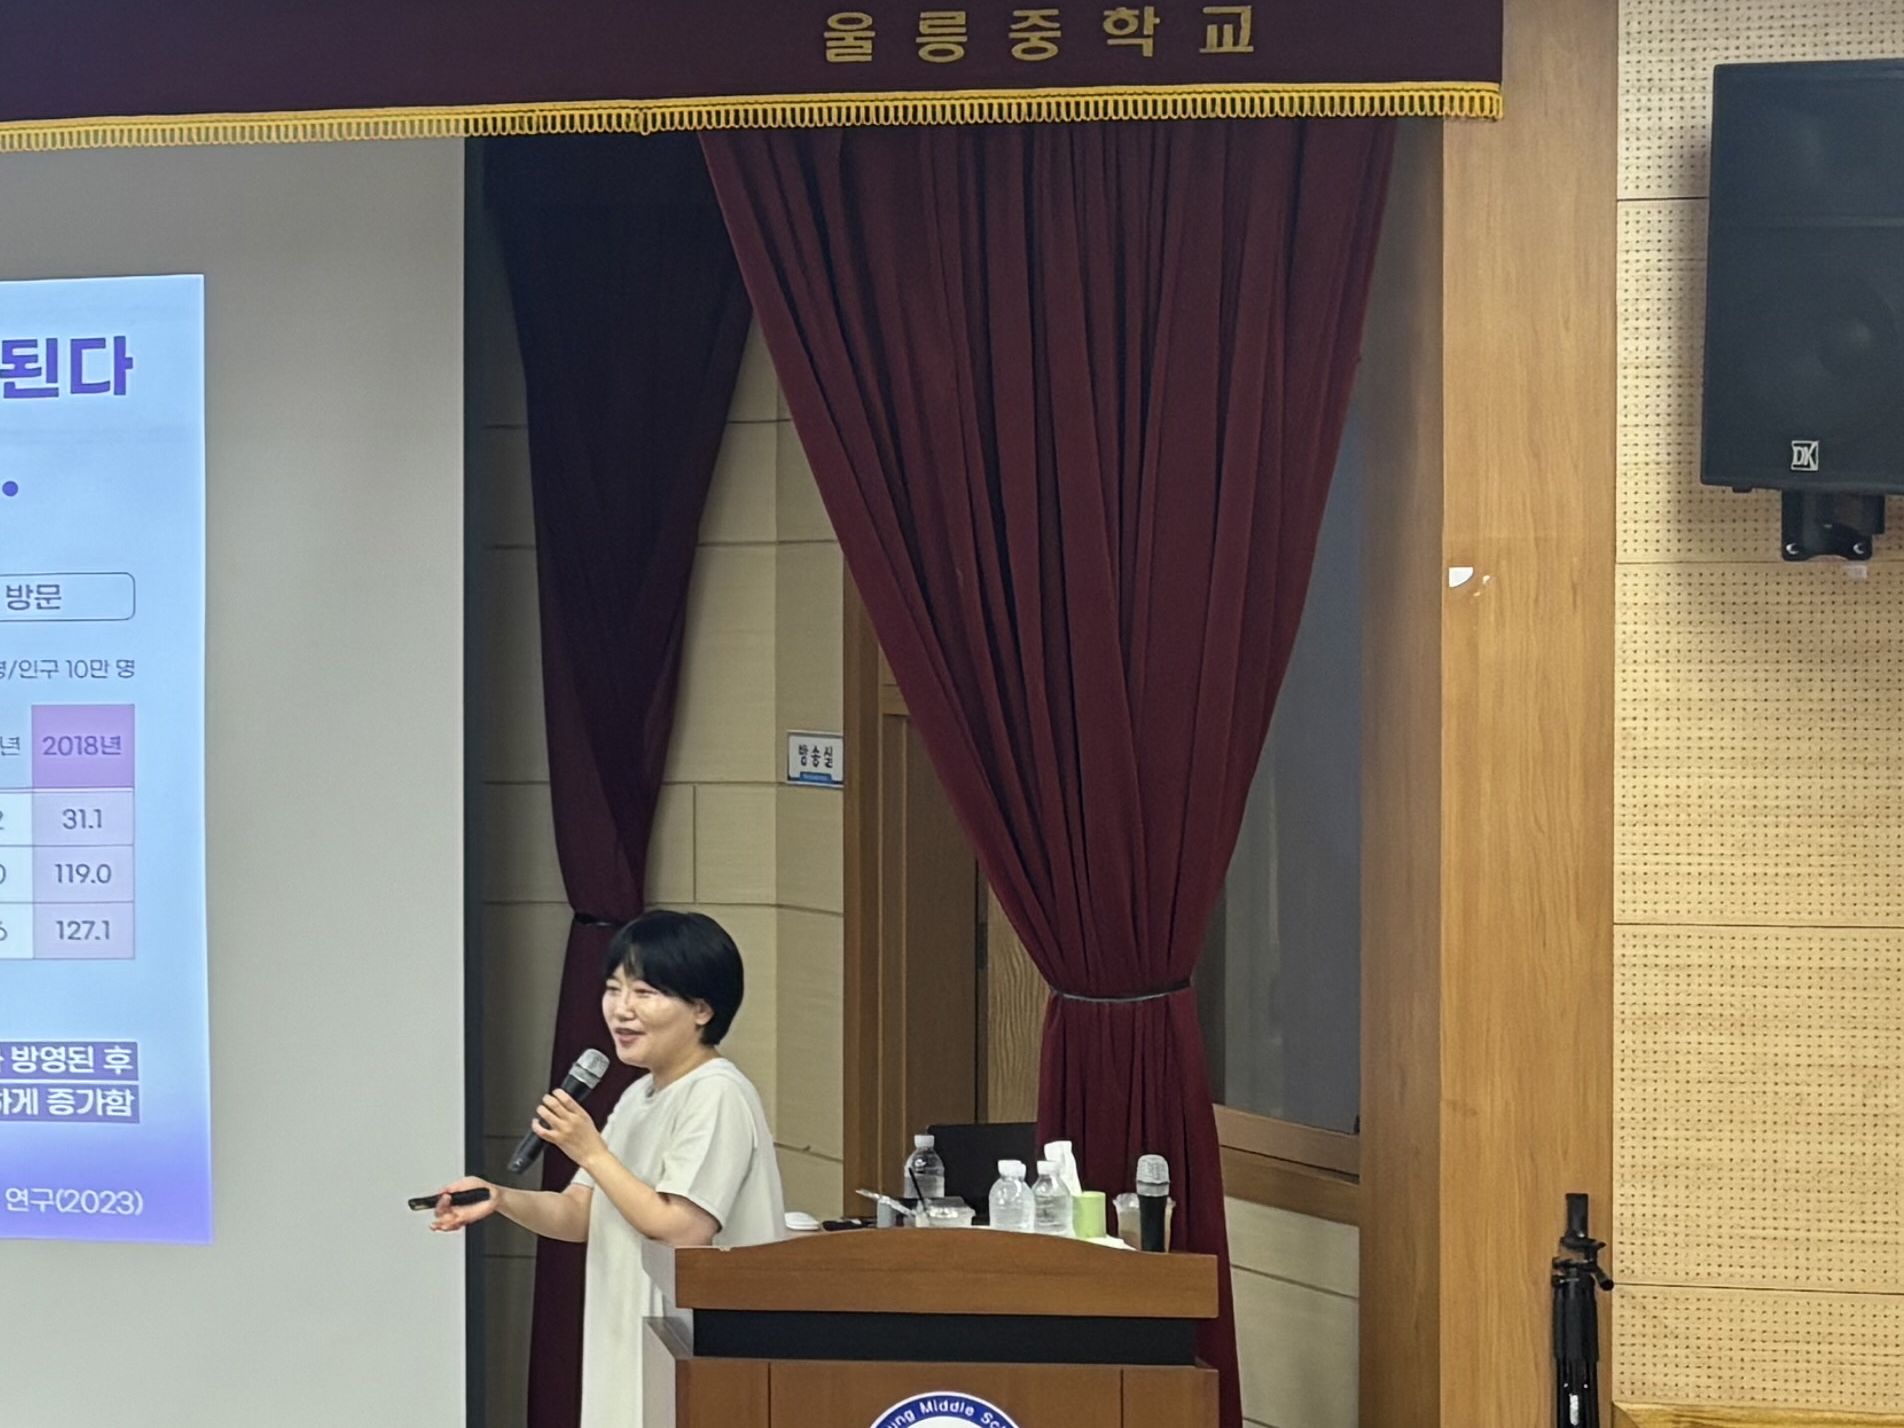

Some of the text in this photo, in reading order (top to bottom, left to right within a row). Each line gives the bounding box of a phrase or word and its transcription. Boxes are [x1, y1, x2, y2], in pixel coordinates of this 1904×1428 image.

[824, 5, 1254, 62] 울릉중학교
[5, 584, 61, 610] 방문
[65, 659, 110, 679] 10만
[117, 659, 135, 679] 명
[42, 735, 122, 756] 2018년
[798, 744, 833, 768] 방송실
[62, 809, 103, 829] 31.1
[55, 864, 111, 884] 119.0
[55, 920, 111, 941] 127.1
[11, 1046, 94, 1074] 방영된
[103, 1046, 133, 1074] 후
[47, 1089, 134, 1117] 증가함
[5, 1188, 143, 1216] 연구(2023)
[920, 1400, 975, 1416] Middle
